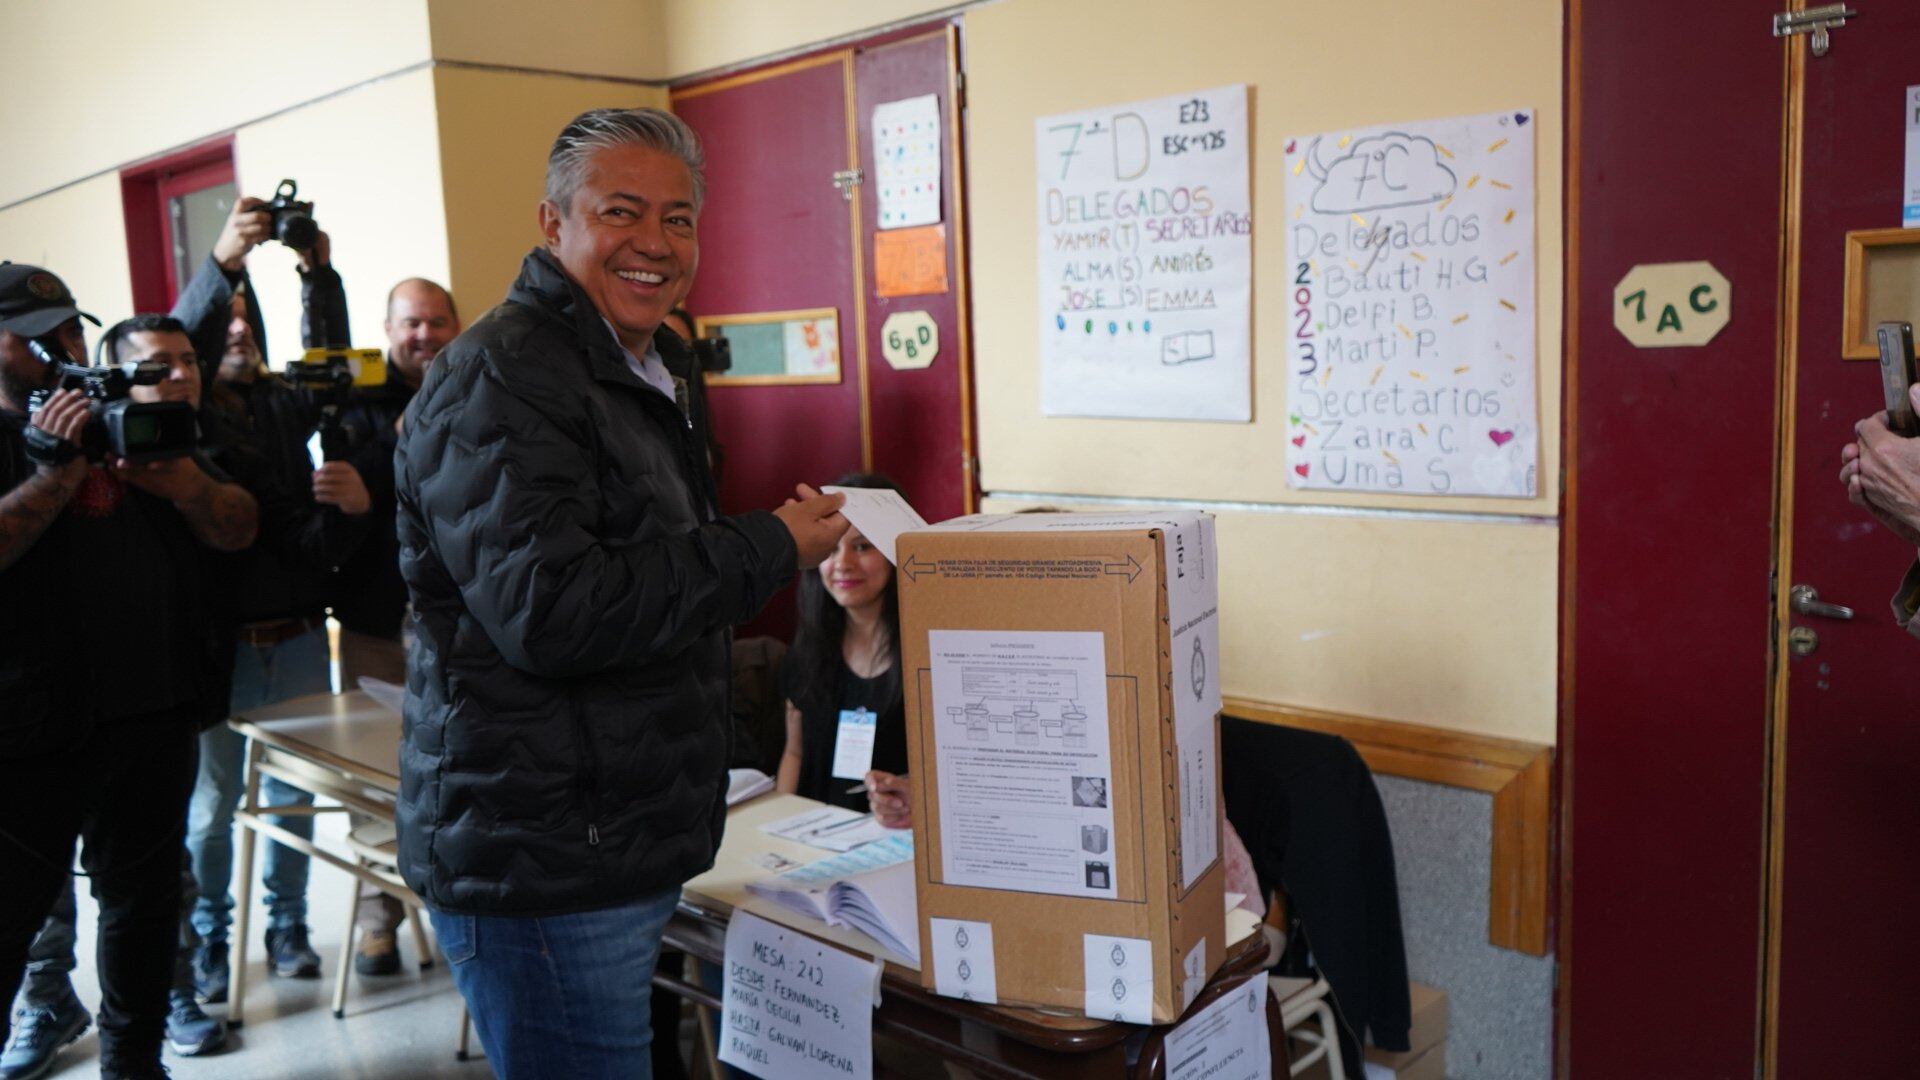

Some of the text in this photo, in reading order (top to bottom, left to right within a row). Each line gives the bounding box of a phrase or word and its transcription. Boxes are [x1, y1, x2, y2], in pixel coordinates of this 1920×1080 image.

[1179, 98, 1210, 124] E23
[1047, 185, 1215, 226] DELEGADOS
[1150, 246, 1214, 274] ANDRÉS
[1324, 260, 1421, 299] Bauti
[1146, 288, 1217, 312] EMMA
[1325, 299, 1396, 330] Delfi
[1326, 332, 1397, 363] Marti
[1298, 376, 1501, 420] Secretarios
[1320, 420, 1415, 451] Zaira
[1323, 456, 1404, 488] Uma
[1176, 534, 1185, 579] Faja
[797, 960, 824, 987] 212
[732, 1037, 770, 1065] RAQUEL
[810, 1043, 854, 1074] LORENA
